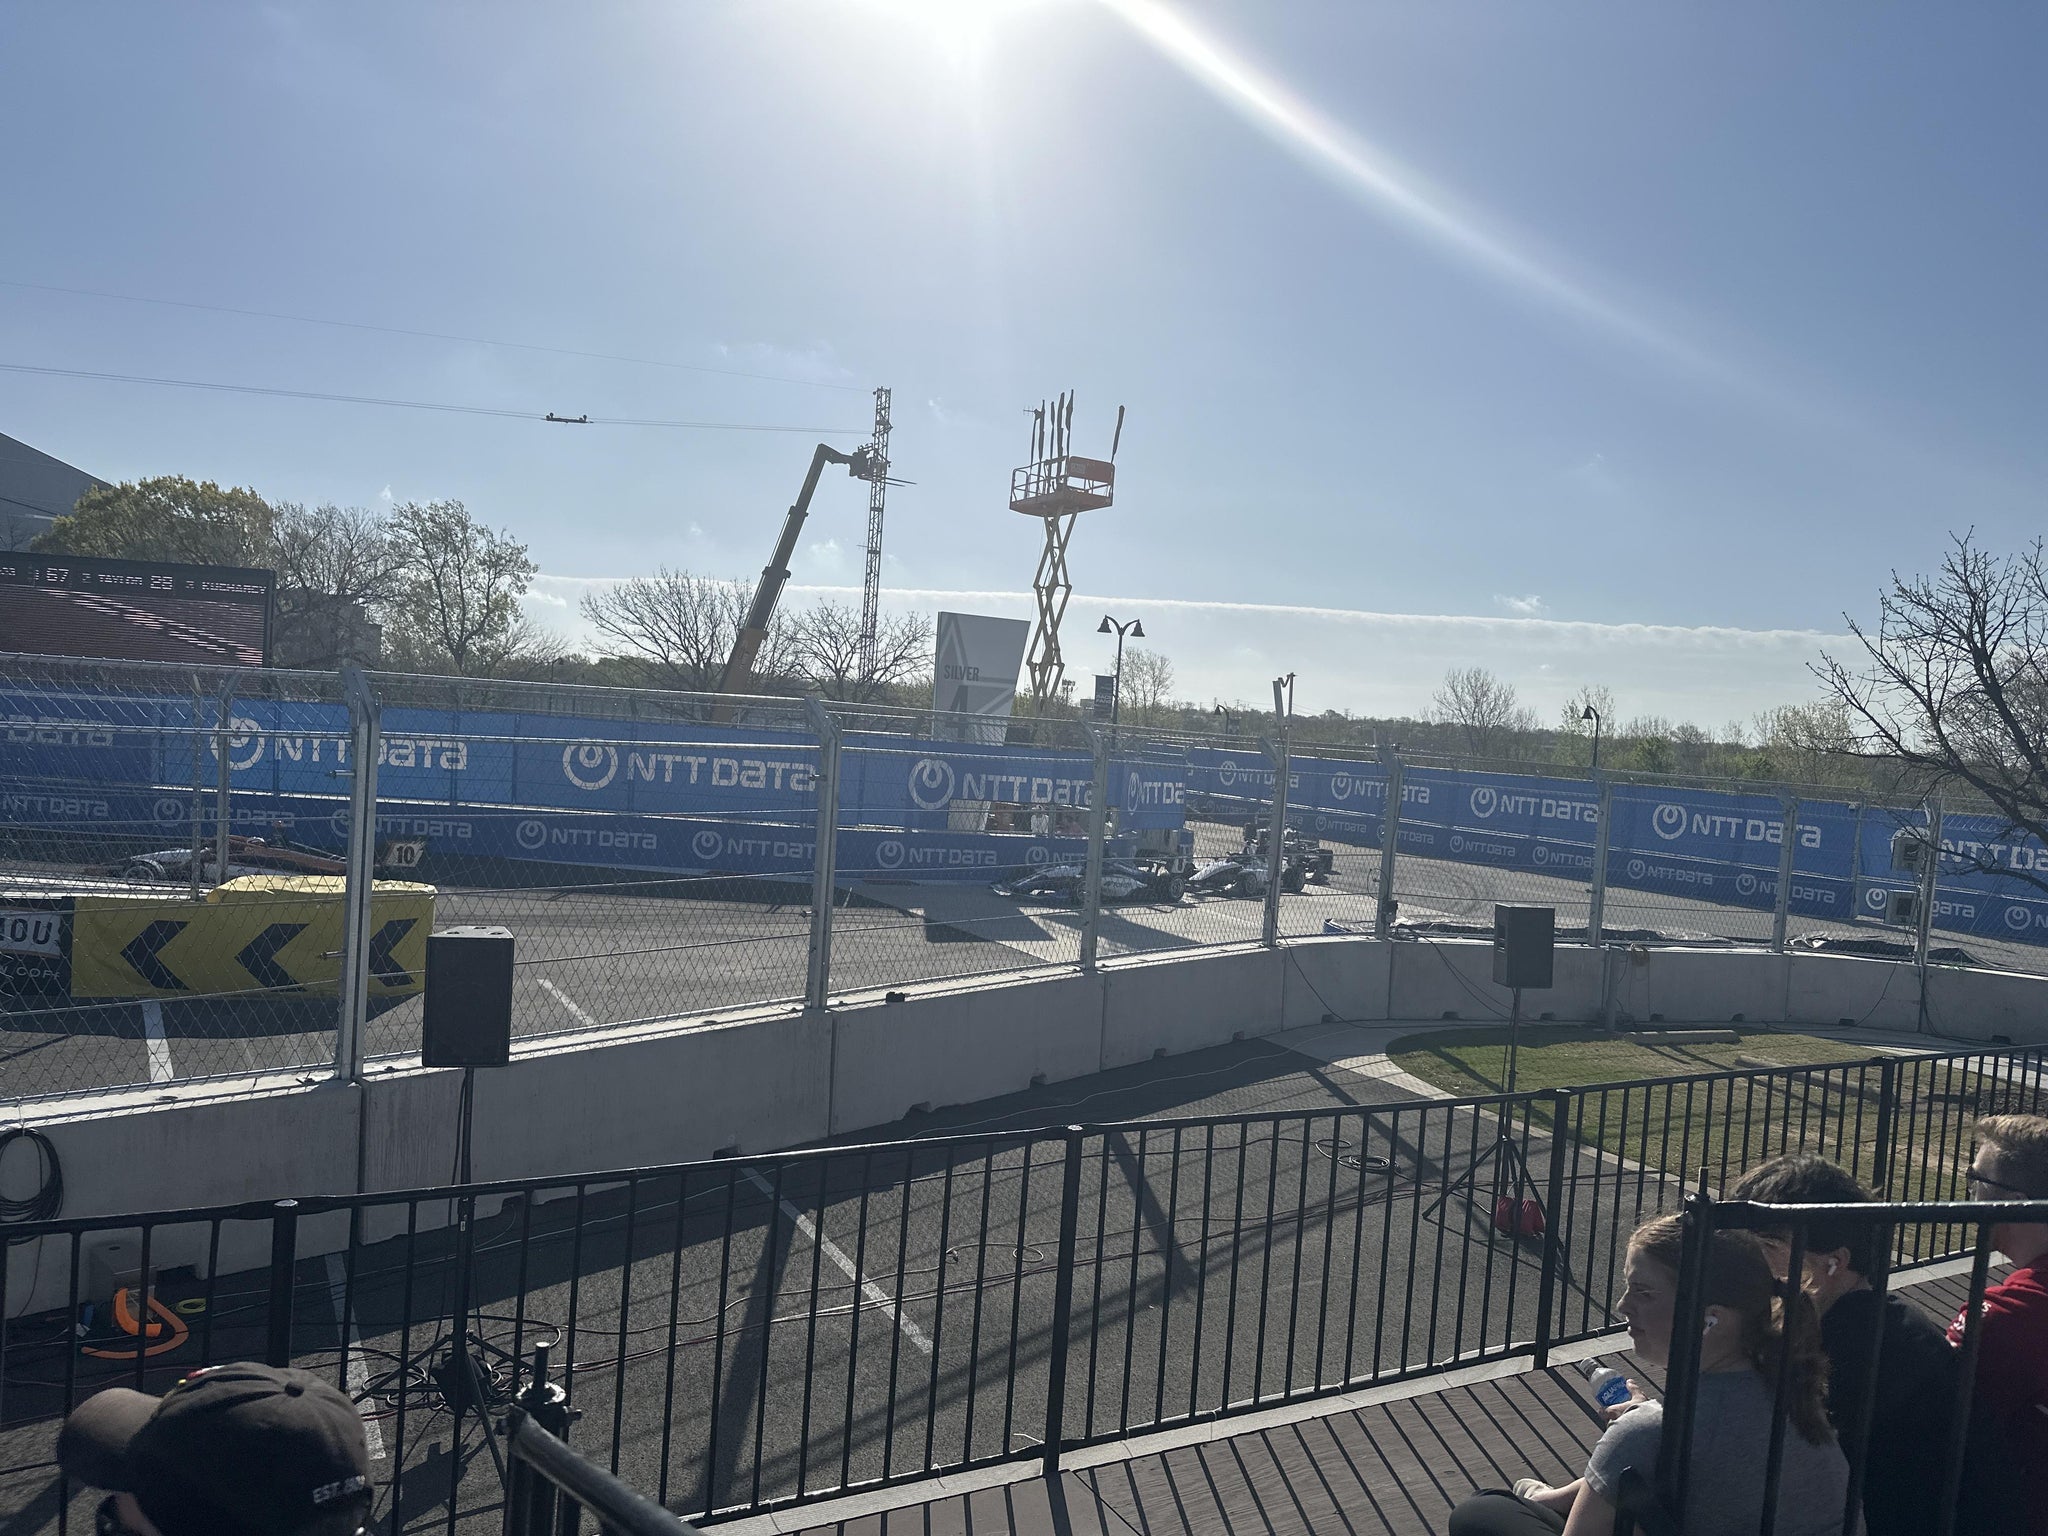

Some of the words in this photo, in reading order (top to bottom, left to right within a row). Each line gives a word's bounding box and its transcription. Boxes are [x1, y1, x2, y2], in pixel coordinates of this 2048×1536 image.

[98, 574, 142, 586] TAYLOR
[150, 575, 173, 590] 28
[944, 664, 980, 681] SILVER
[628, 751, 707, 784] NTT
[962, 772, 1028, 801] NTT
[1354, 780, 1383, 798] NTT
[1500, 794, 1541, 816] NTT
[1691, 812, 1743, 838] NTT
[551, 828, 598, 845] NTT
[397, 845, 415, 865] 10
[728, 838, 773, 856] NTT
[909, 847, 946, 863] NTT
[1465, 840, 1488, 854] NTT
[1940, 838, 2007, 867] NTT
[1551, 852, 1574, 866] NTT
[1648, 865, 1675, 879] NTT
